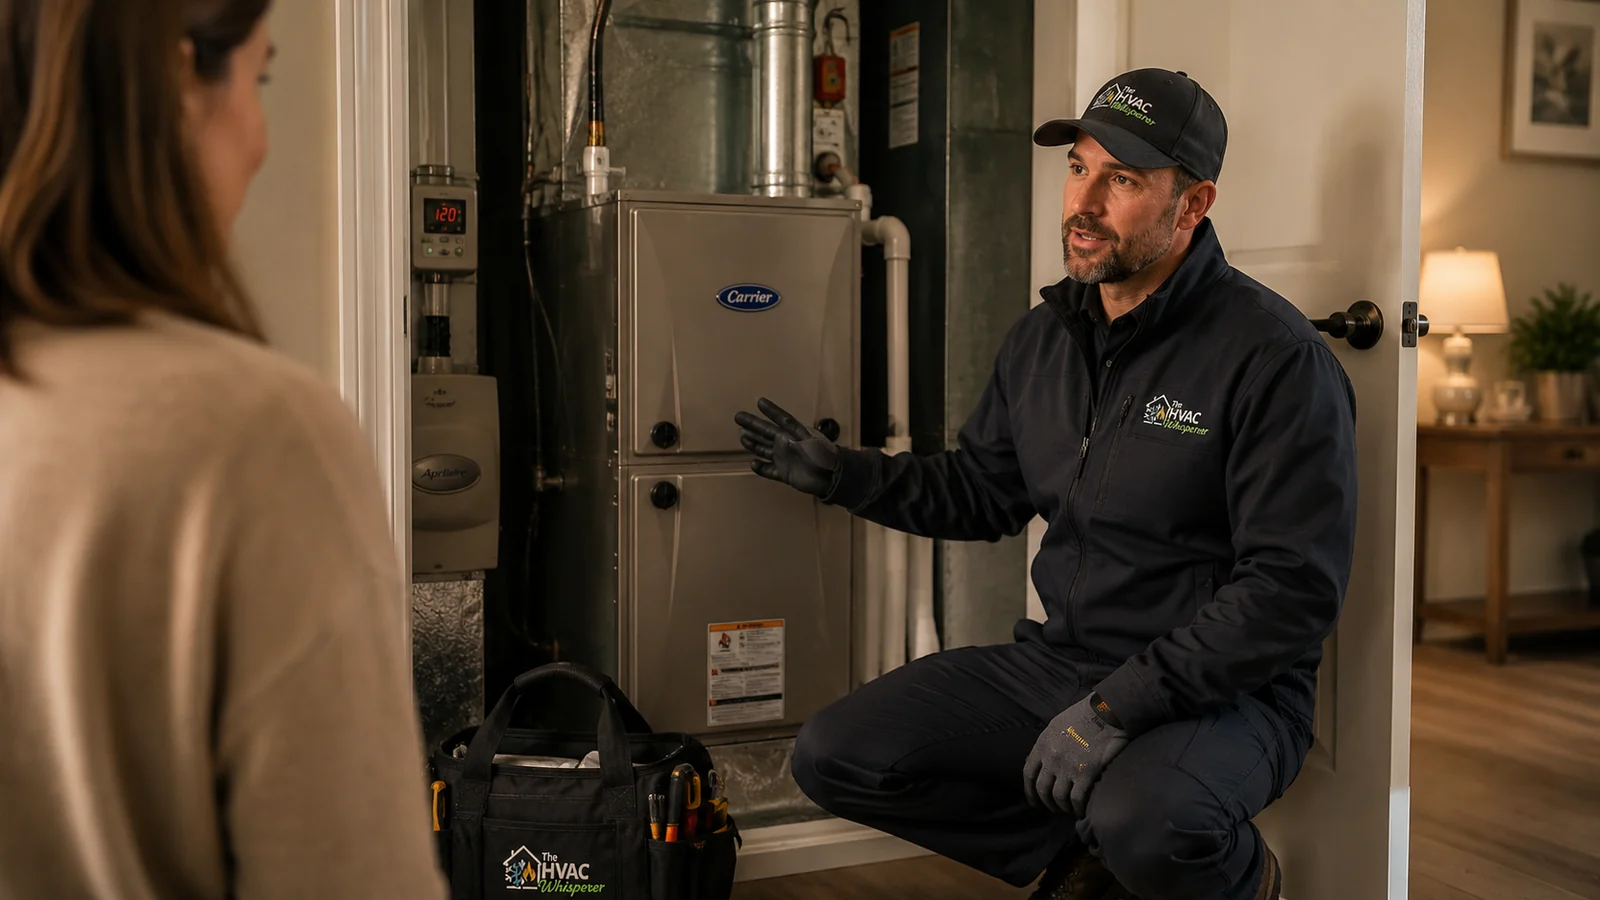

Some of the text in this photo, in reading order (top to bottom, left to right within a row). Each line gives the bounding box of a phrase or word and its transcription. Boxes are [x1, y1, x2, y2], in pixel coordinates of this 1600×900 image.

[1117, 92, 1153, 114] HVAC
[435, 207, 457, 222] 120
[727, 290, 773, 304] Carrier
[1168, 407, 1202, 424] HVAC
[541, 852, 558, 862] The
[541, 862, 590, 880] HVAC
[538, 879, 605, 897] Whisperer
